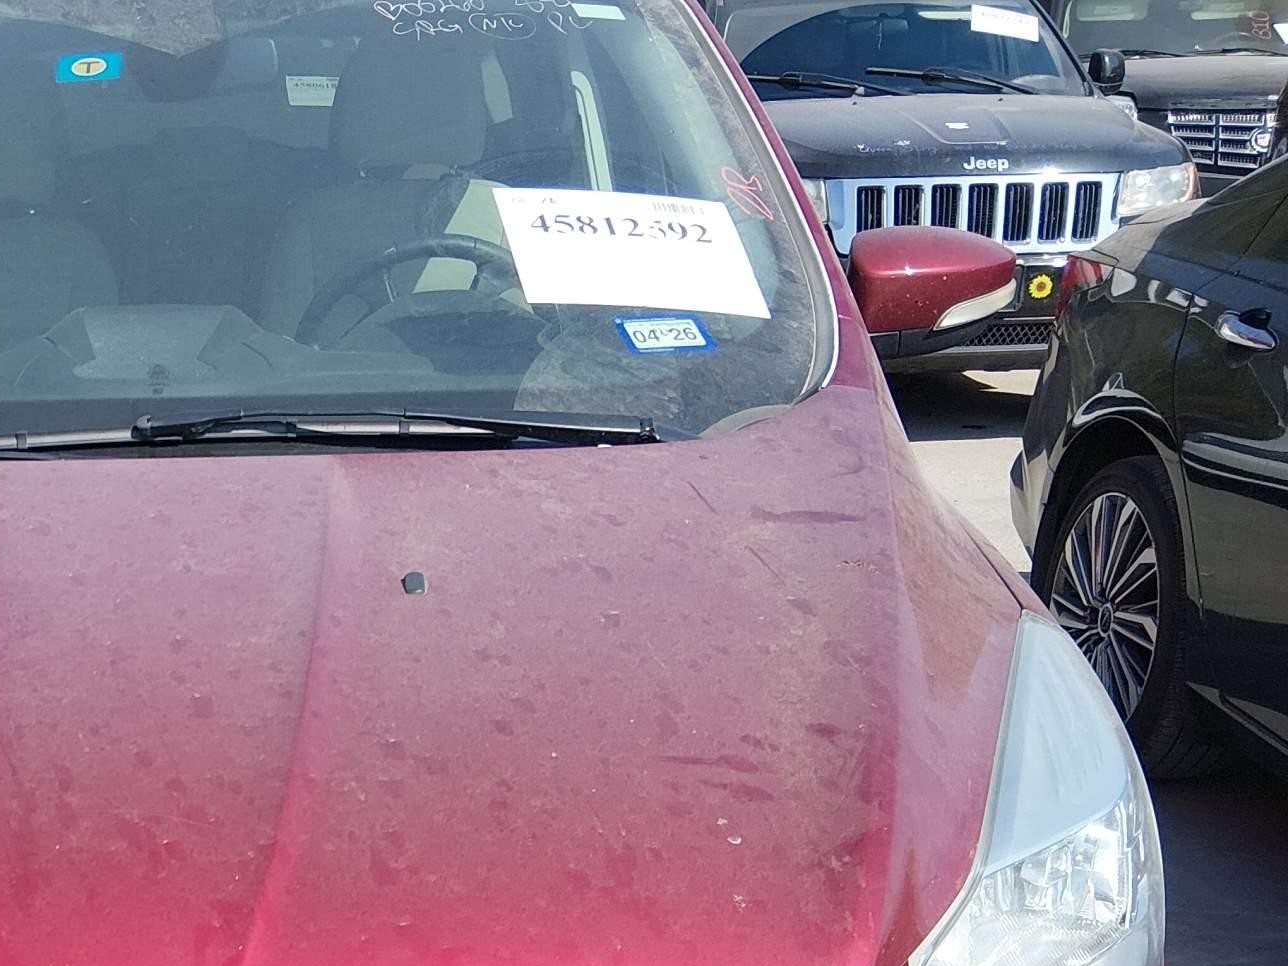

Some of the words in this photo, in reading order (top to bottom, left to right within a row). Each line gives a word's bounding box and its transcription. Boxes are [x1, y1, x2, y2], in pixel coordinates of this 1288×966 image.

[963, 156, 1009, 171] Jeep
[530, 214, 713, 244] 45812592
[633, 328, 660, 343] 04
[669, 327, 697, 341] 26
